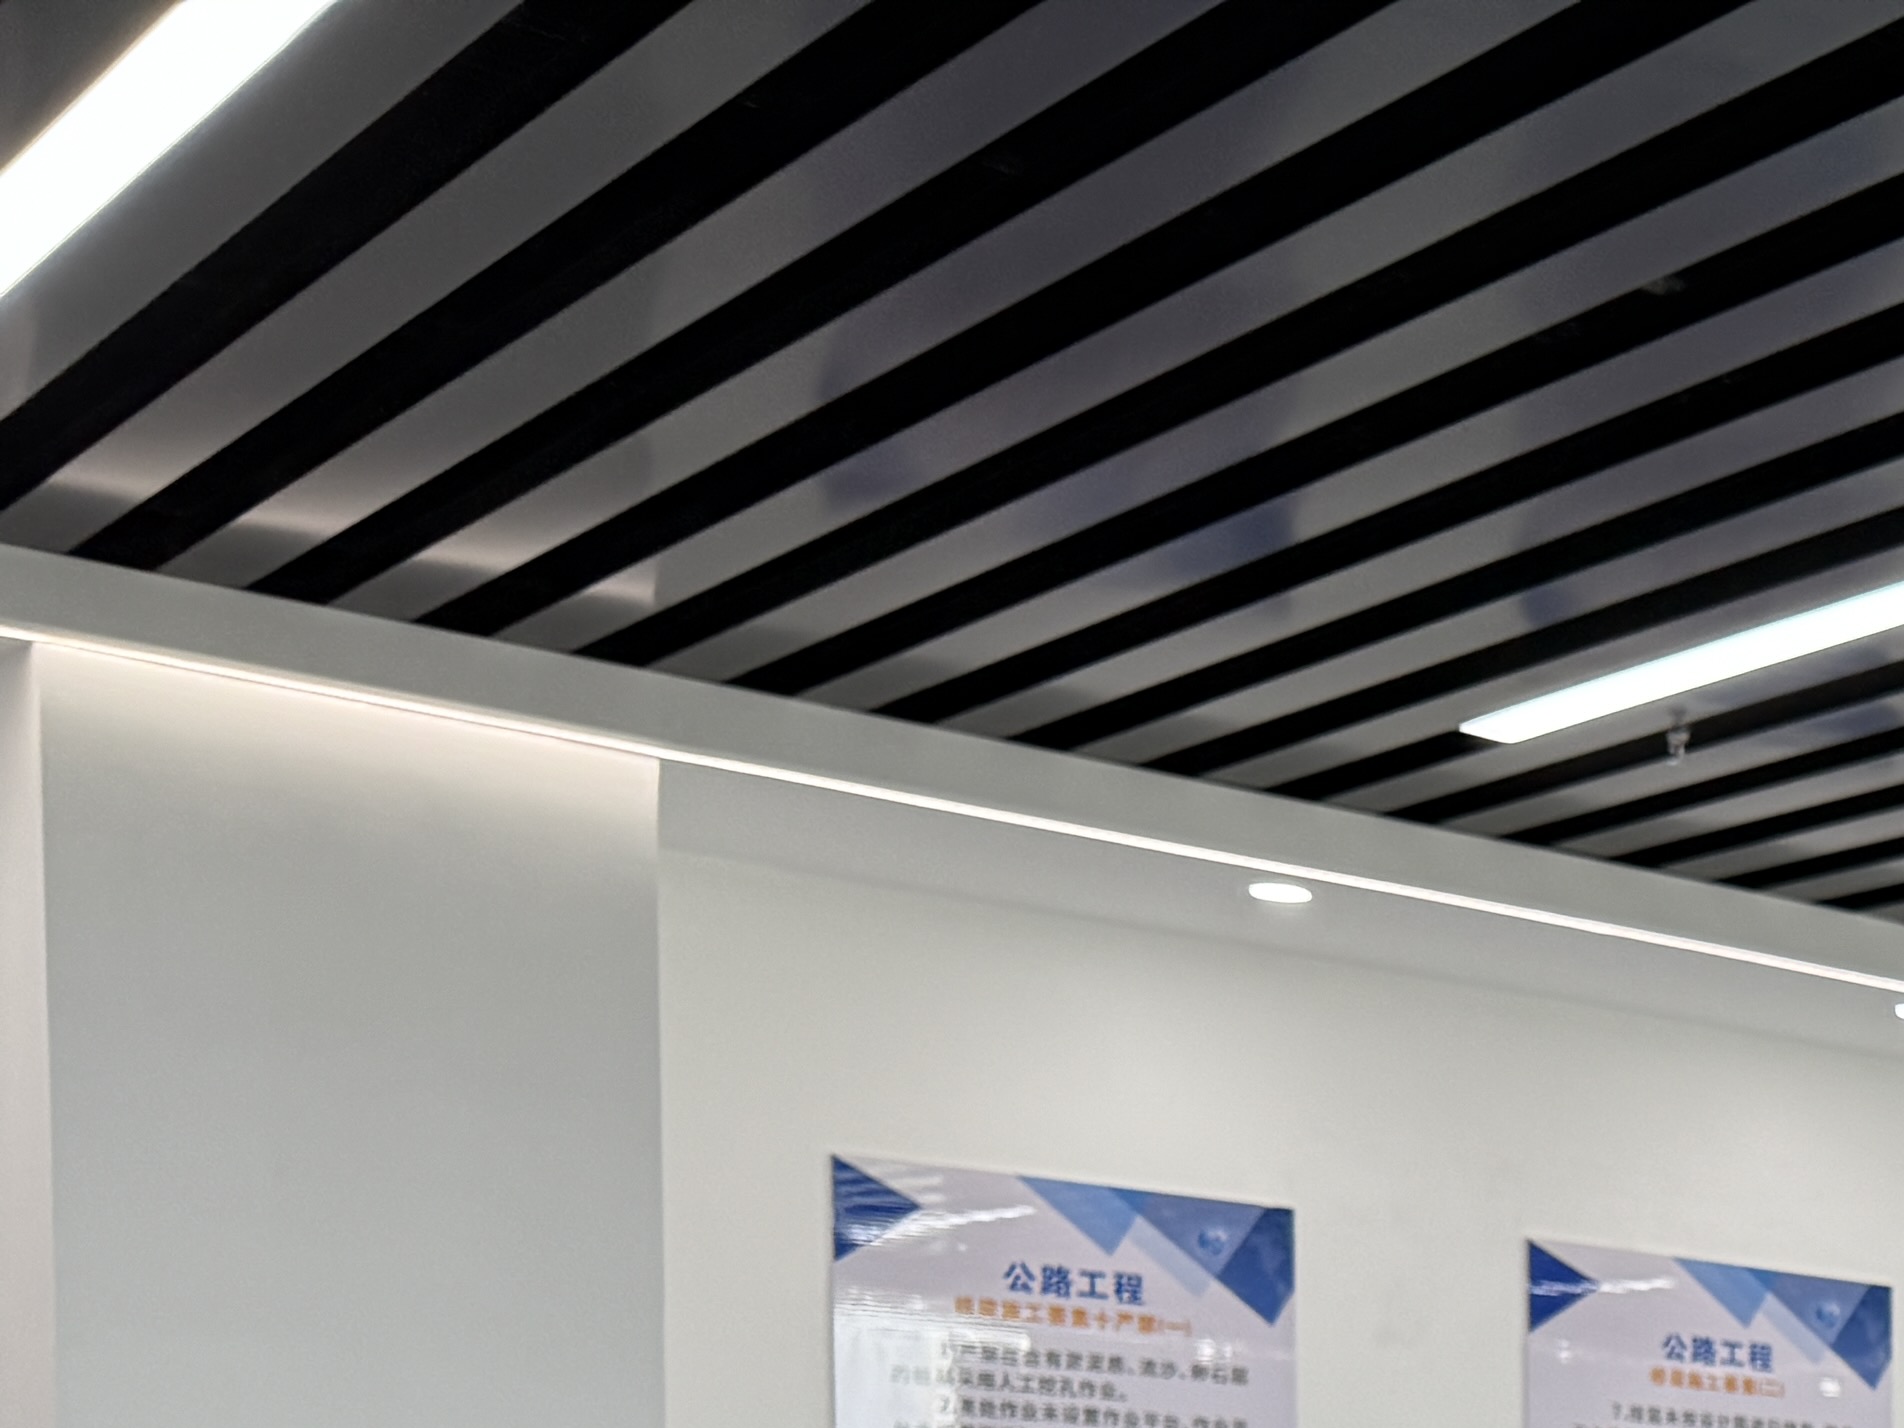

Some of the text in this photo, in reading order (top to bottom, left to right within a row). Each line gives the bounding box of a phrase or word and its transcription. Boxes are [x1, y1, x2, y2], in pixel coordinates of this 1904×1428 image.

[1003, 1261, 1144, 1304] 公路工程
[1662, 1333, 1773, 1373] 公路工程
